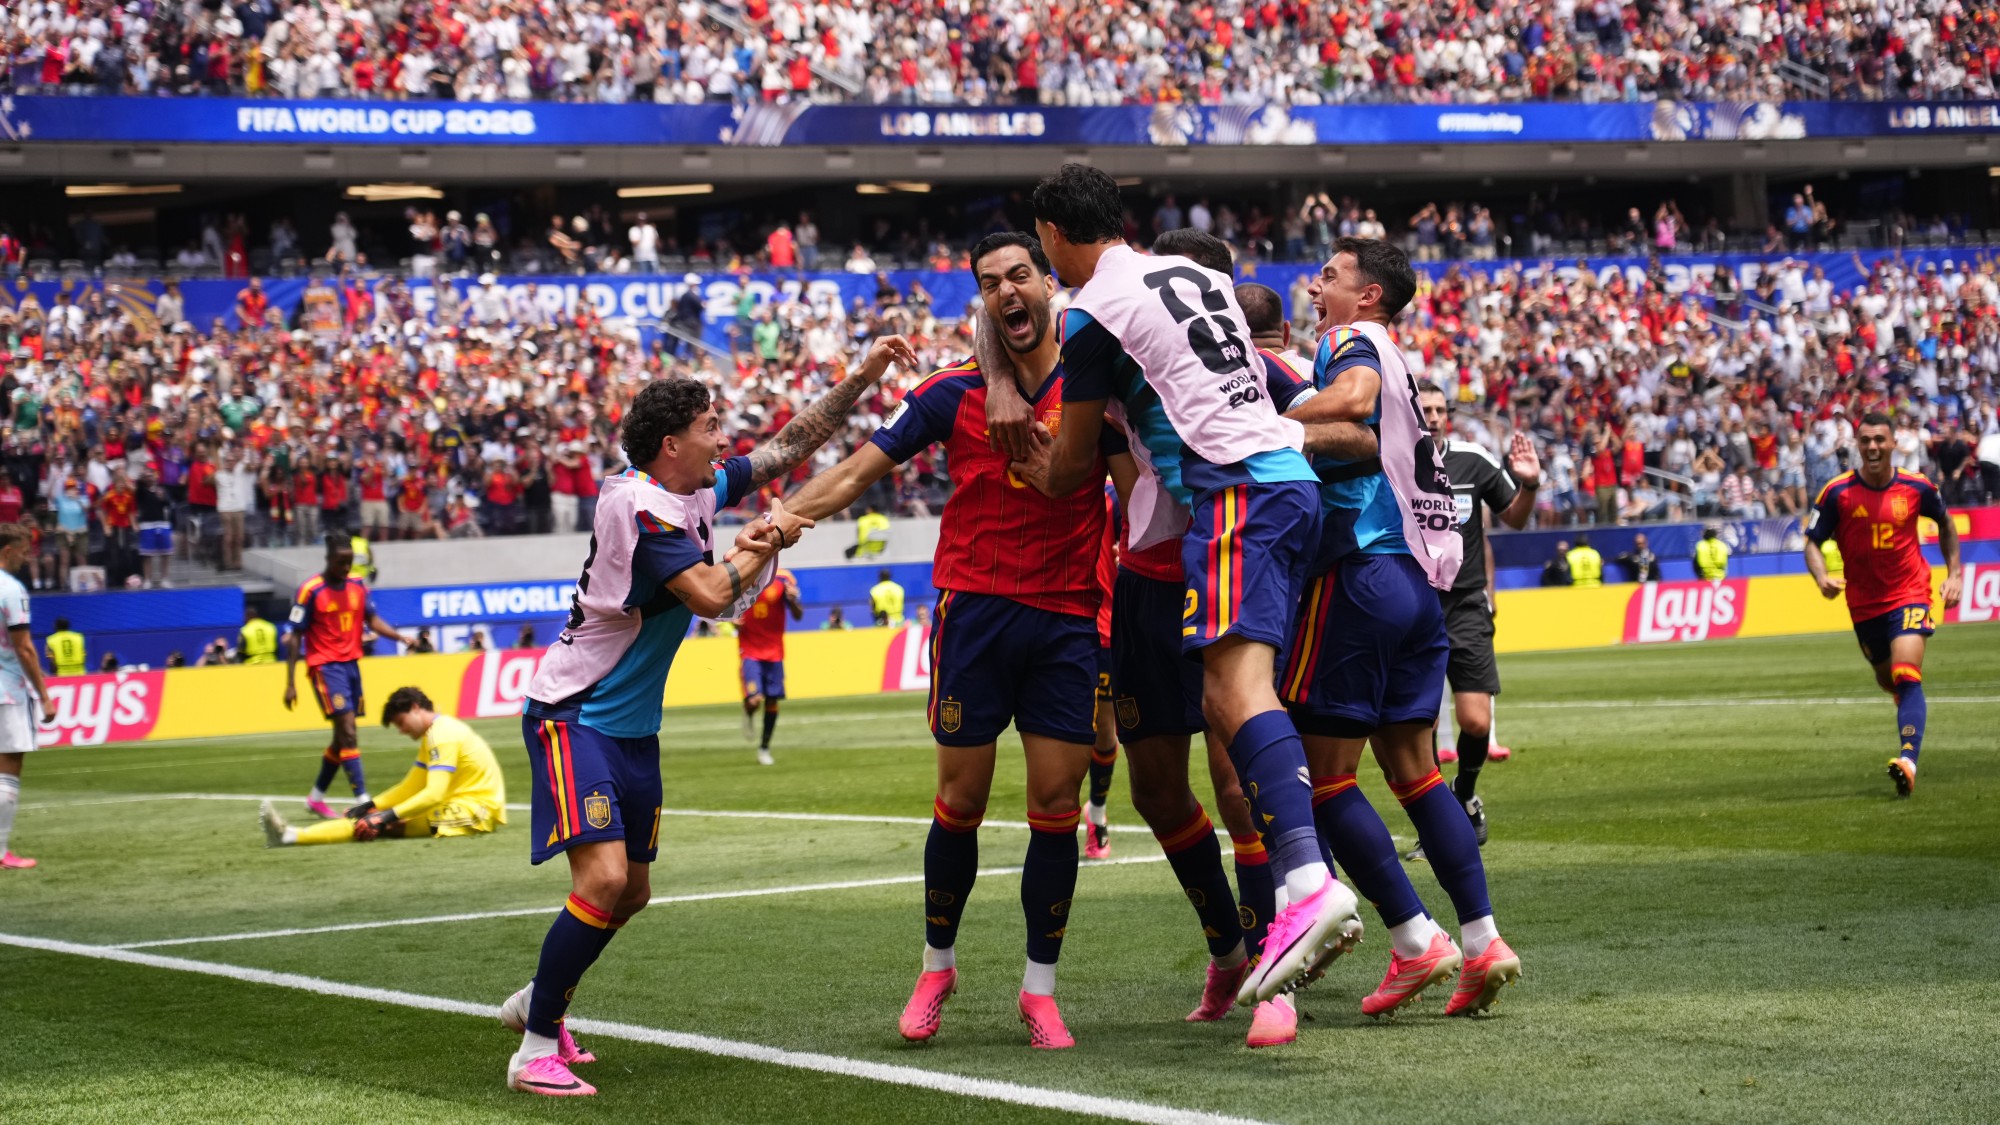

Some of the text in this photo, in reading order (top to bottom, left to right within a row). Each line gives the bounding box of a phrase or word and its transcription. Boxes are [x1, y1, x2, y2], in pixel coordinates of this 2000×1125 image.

[237, 107, 536, 135] FIFA WORLD CUP 2026
[880, 111, 1046, 137] LOS ANGELES
[1889, 106, 1931, 128] LOS
[1872, 523, 1894, 549] 12
[422, 591, 482, 618] FIFA
[1638, 580, 1737, 642] Lay's
[1903, 607, 1926, 630] 12
